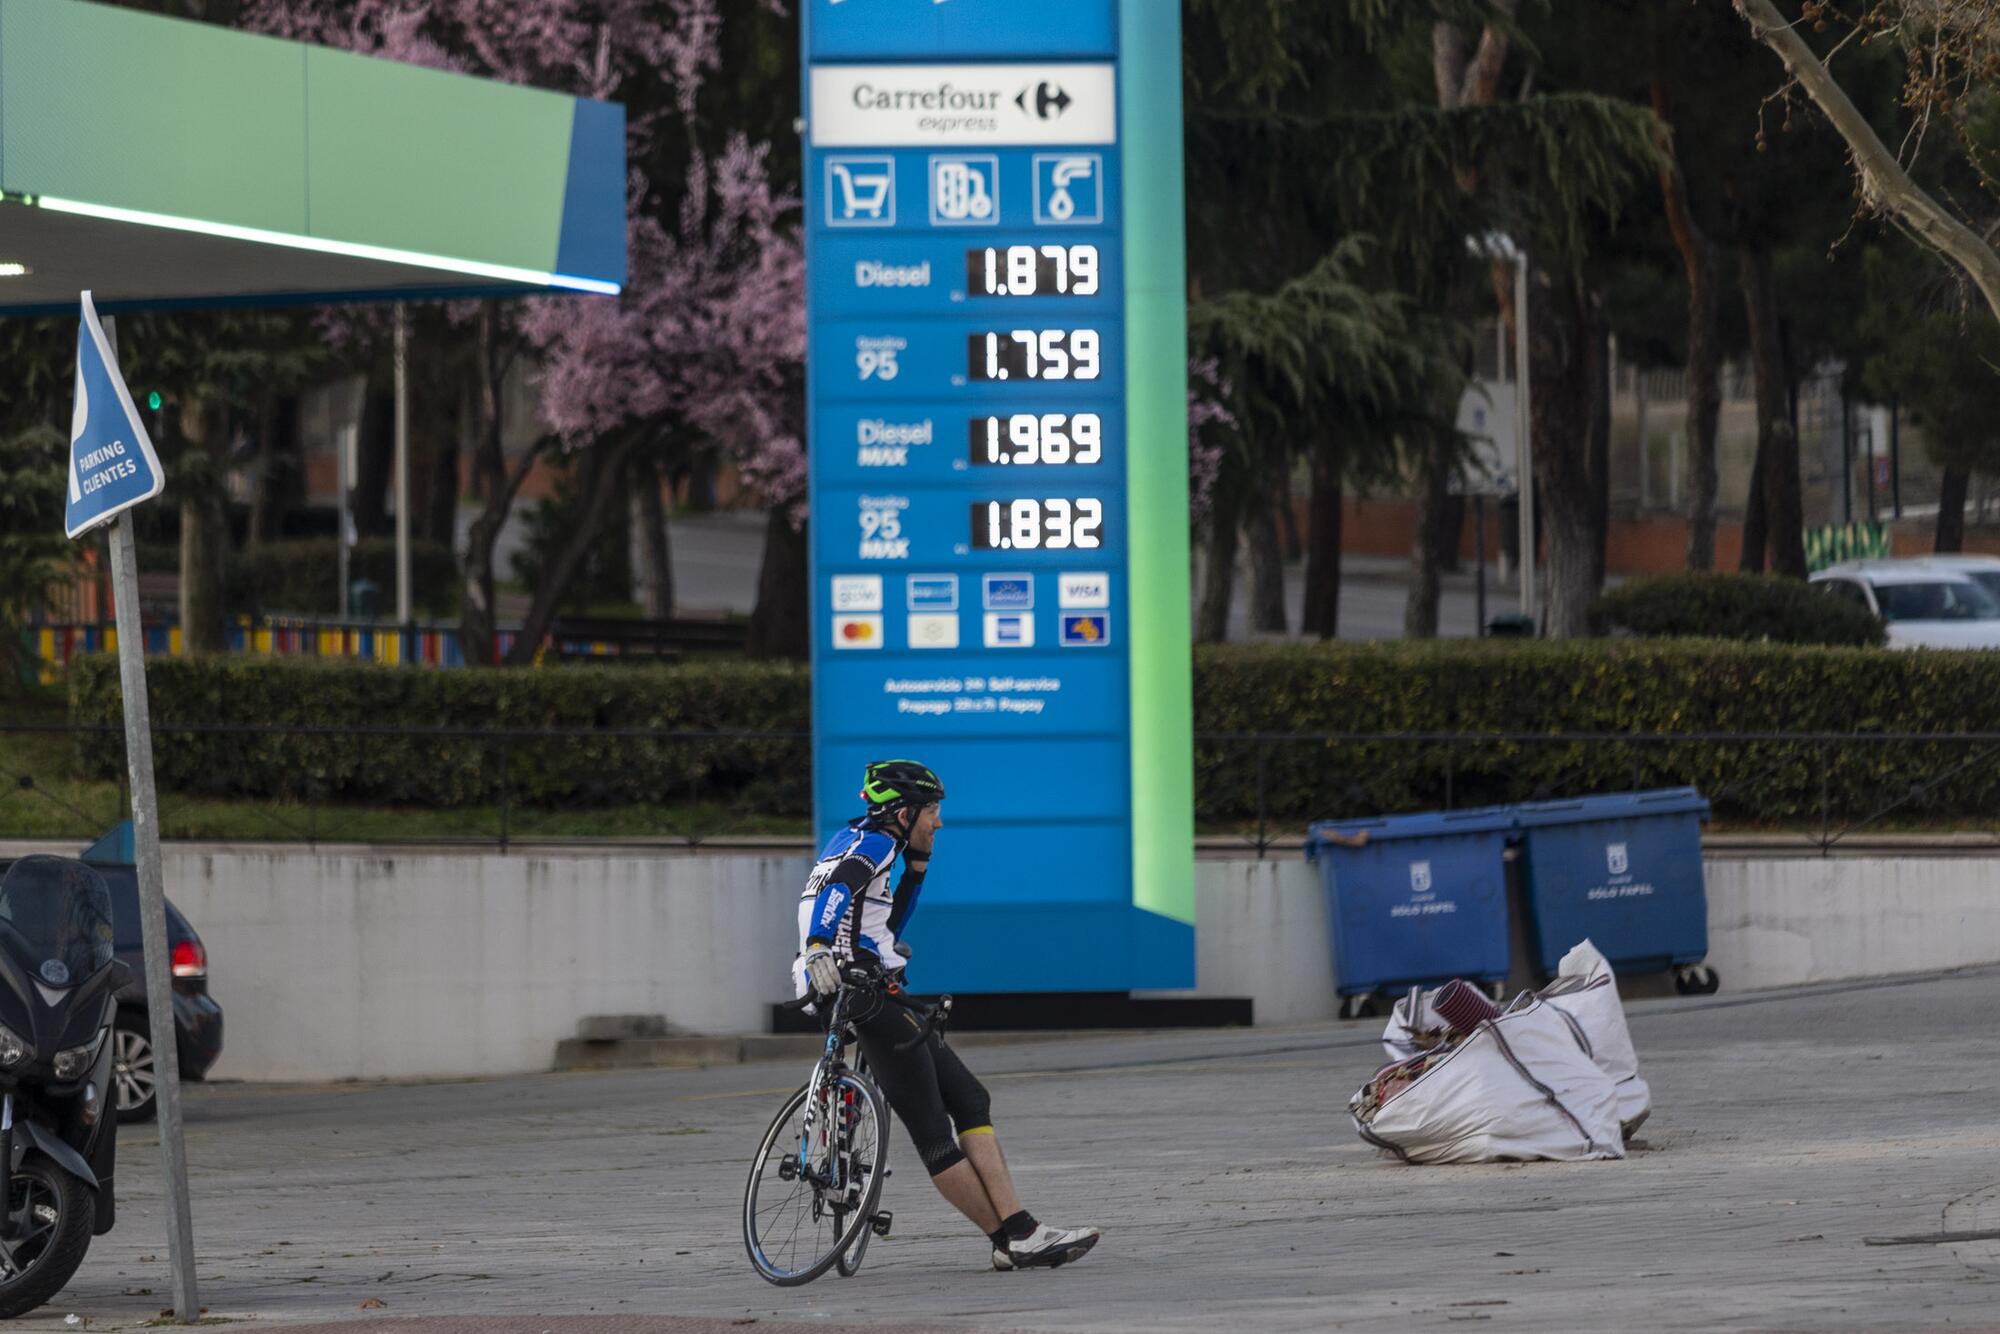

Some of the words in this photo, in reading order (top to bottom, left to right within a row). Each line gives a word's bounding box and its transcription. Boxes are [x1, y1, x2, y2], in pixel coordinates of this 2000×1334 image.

[853, 83, 1001, 110] Carrefour
[917, 116, 998, 135] express
[855, 260, 931, 288] Diesel
[984, 245, 1099, 296] 1.879
[856, 350, 899, 381] 95
[986, 329, 1100, 380] 1.759
[857, 418, 932, 446] Diesel
[986, 413, 1102, 465] 1.969
[79, 440, 125, 472] PARKING
[857, 447, 908, 467] MAX
[83, 458, 136, 495] CLIENTES
[858, 510, 901, 539] 95
[988, 497, 1103, 549] 1.832
[858, 538, 910, 560] MAX
